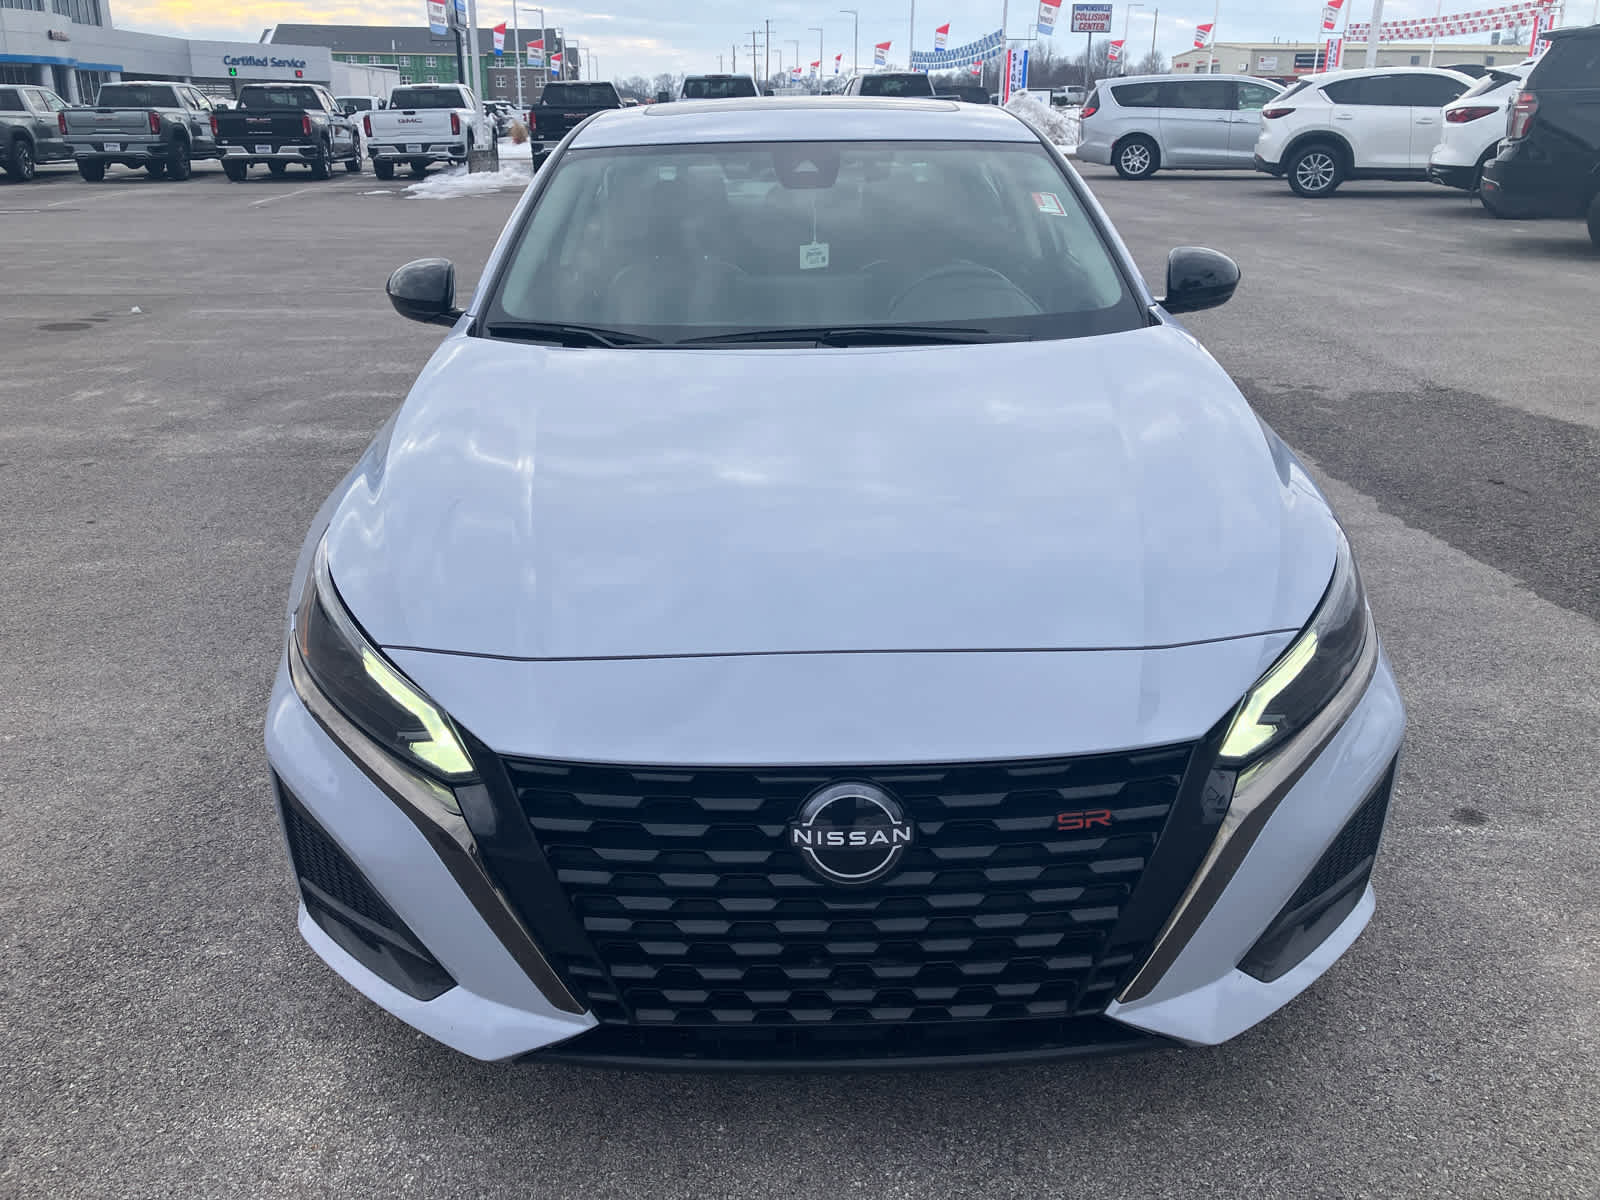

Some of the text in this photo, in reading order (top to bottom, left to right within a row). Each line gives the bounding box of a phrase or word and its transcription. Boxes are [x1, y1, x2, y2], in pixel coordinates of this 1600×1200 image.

[1075, 12, 1110, 21] COLLISION
[1078, 22, 1105, 31] CENTER
[223, 55, 306, 68] Certified Service
[1057, 809, 1111, 831] SR
[793, 826, 911, 846] NISSAN
